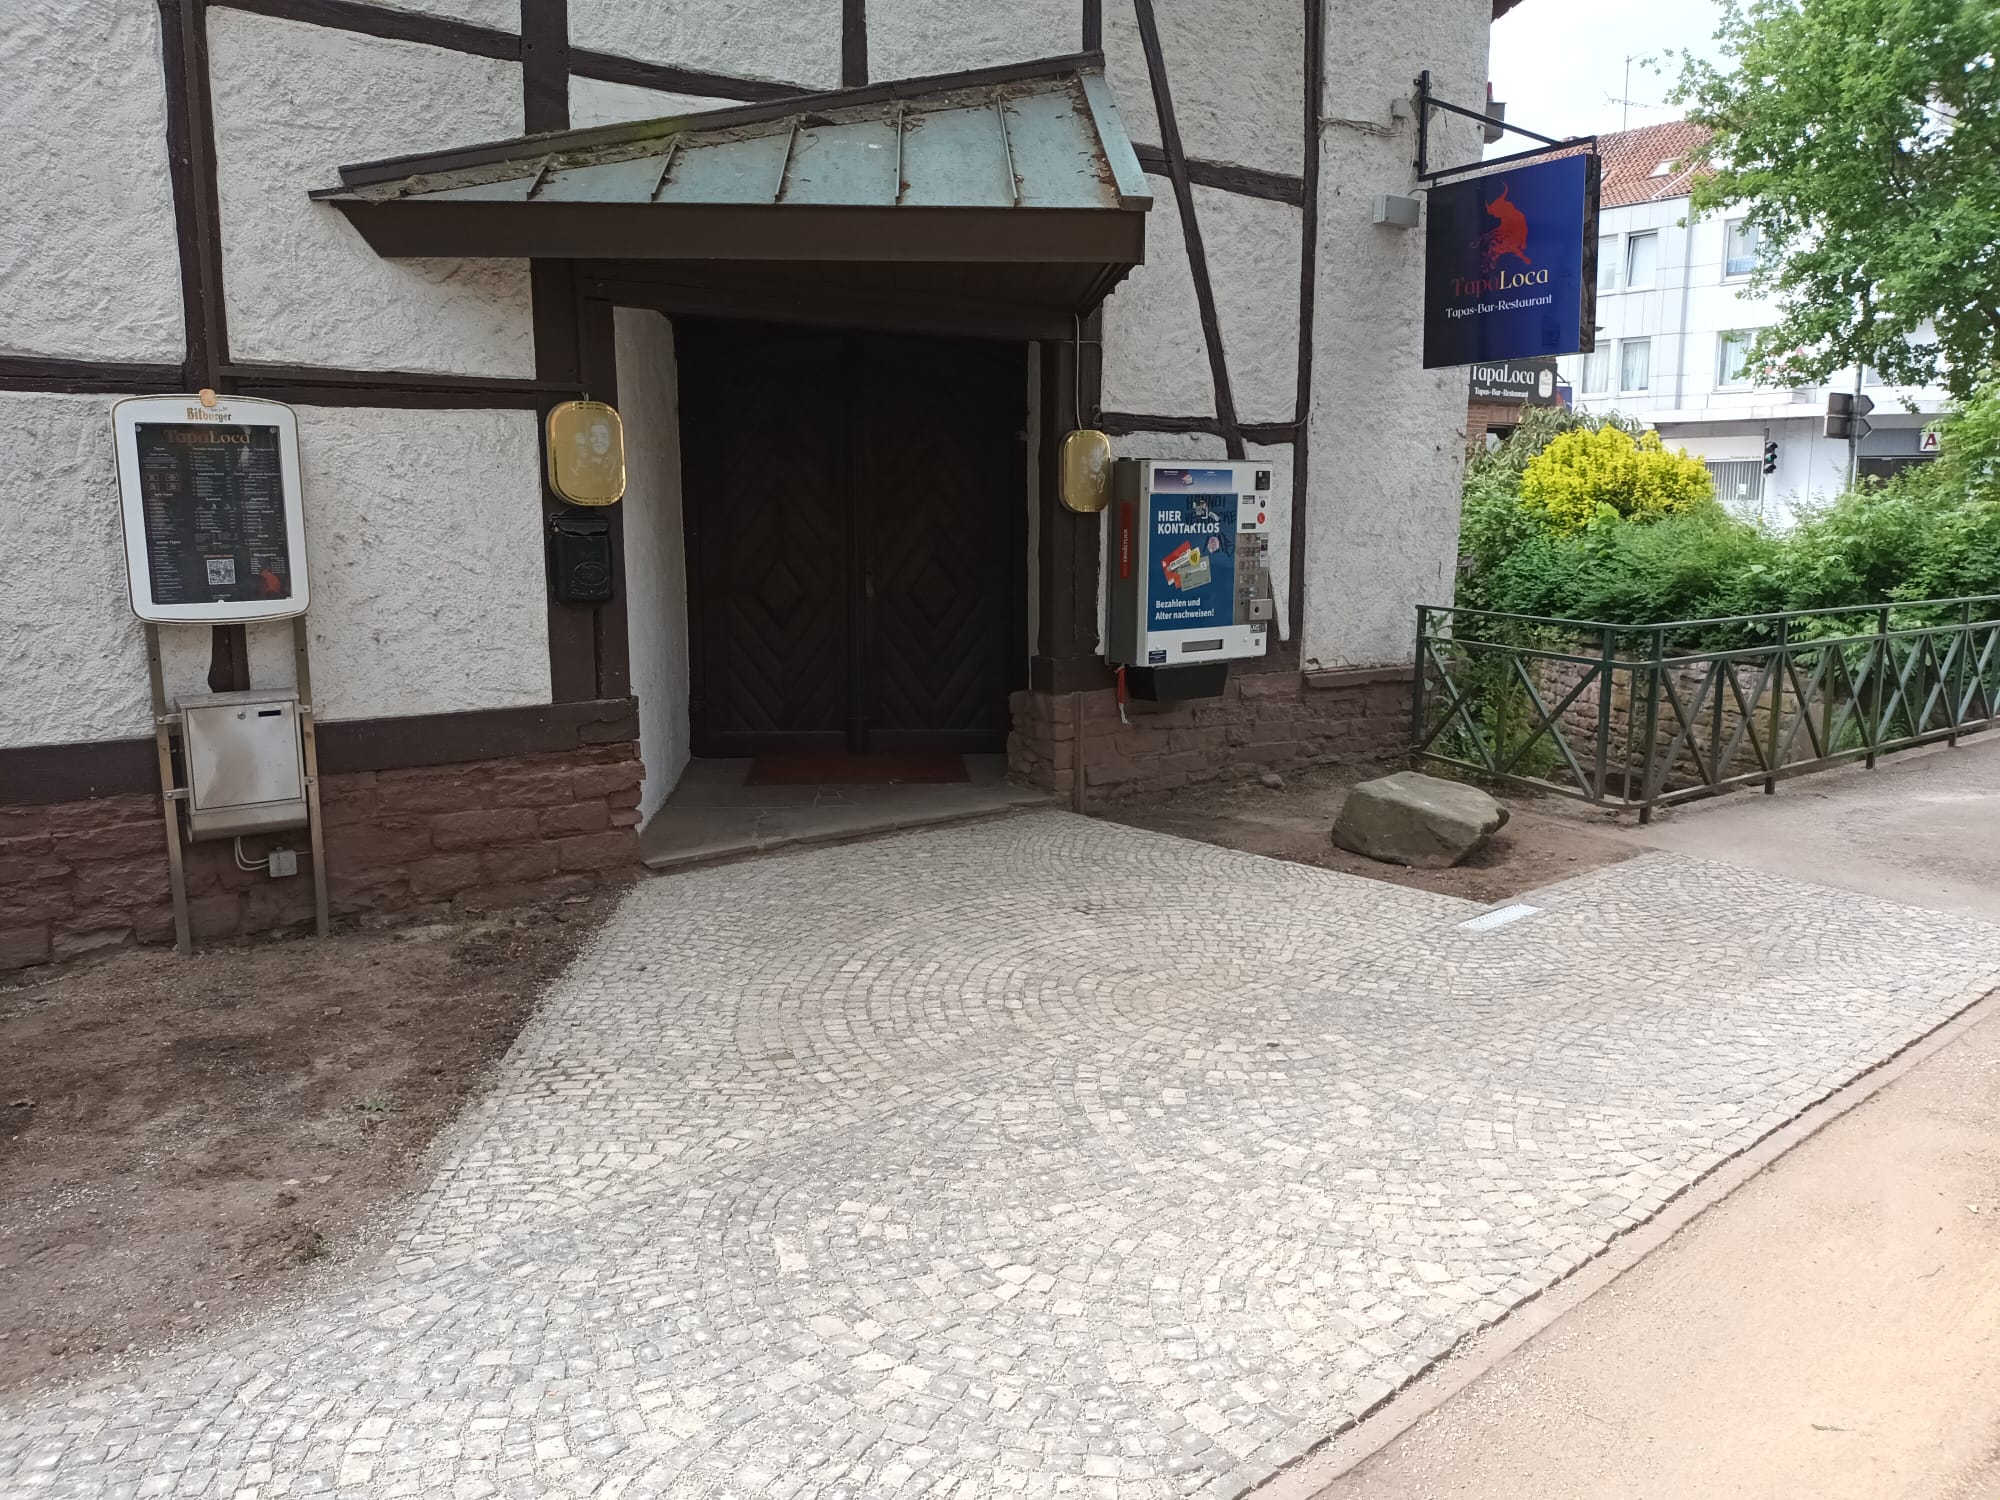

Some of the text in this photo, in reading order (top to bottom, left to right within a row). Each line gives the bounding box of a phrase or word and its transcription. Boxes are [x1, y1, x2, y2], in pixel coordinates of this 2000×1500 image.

[1451, 268, 1550, 298] TapaLoca
[1446, 294, 1552, 319] Tapas-Bar-Restaurant
[1472, 364, 1535, 386] TapaLoca
[187, 407, 232, 423] Bitburger
[163, 430, 250, 446] TapaLoca
[1158, 510, 1181, 522] HIER
[1157, 522, 1220, 535] KONTAKTLOS
[1155, 597, 1201, 608] Bezahlen und
[1155, 608, 1215, 620] Alter nachweisen!
